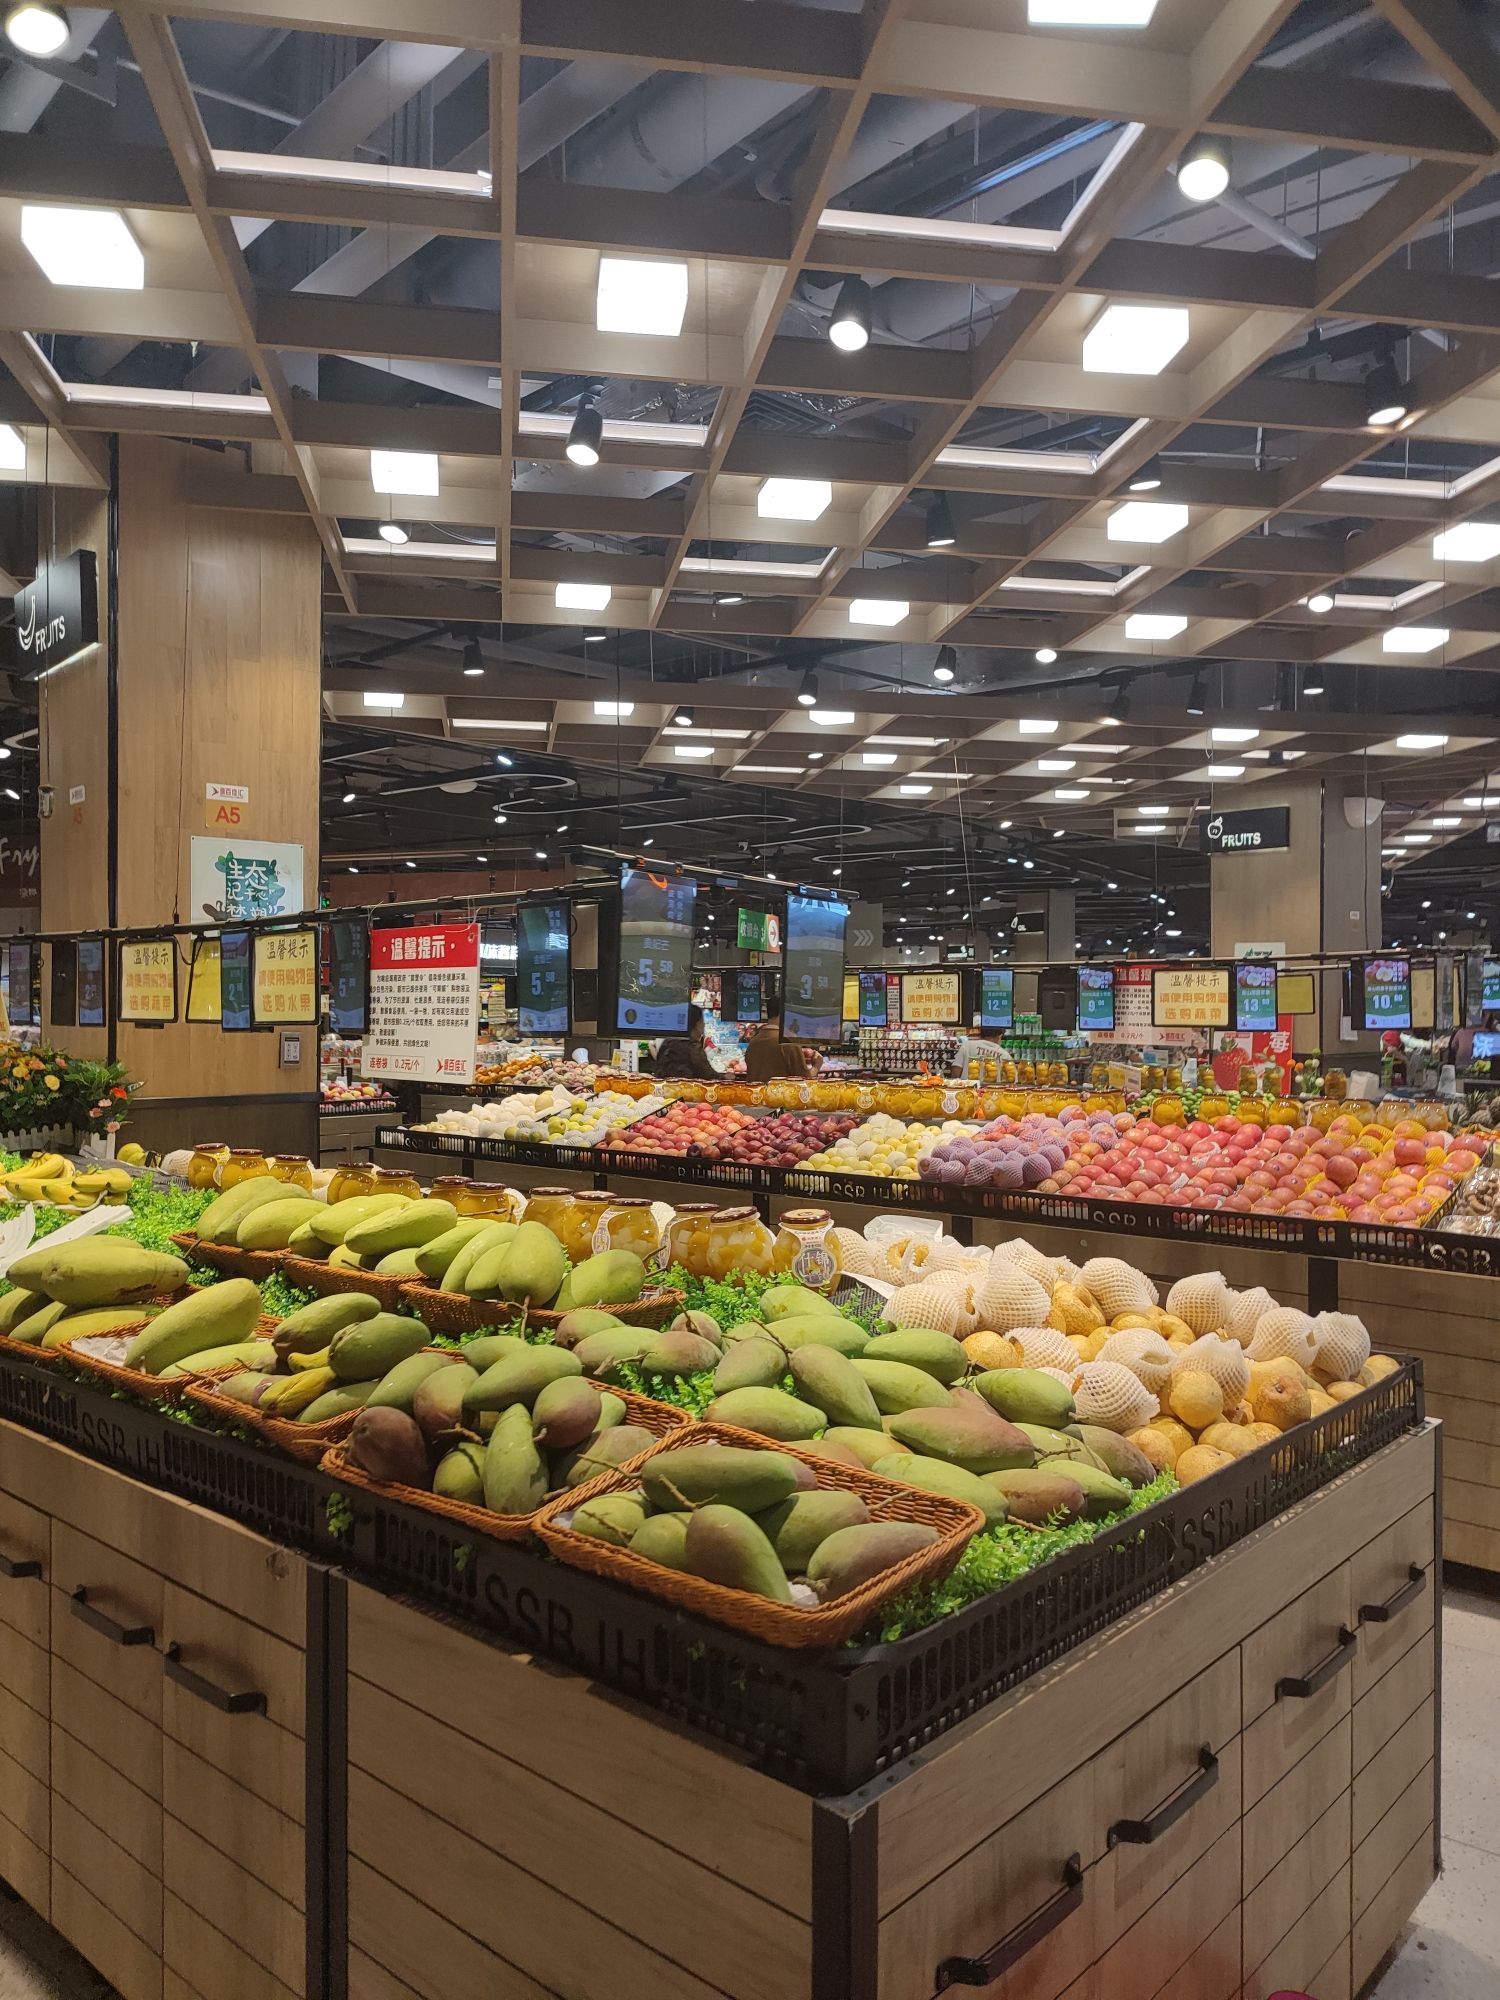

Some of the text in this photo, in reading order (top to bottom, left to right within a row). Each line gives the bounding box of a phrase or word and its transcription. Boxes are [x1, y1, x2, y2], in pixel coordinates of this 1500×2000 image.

[36, 616, 65, 655] FRUITS
[216, 806, 240, 824] A5
[1222, 832, 1261, 847] FRUITS
[226, 859, 269, 890] 生态
[267, 939, 308, 960] 温馨提示
[391, 935, 445, 960] 温馨提示
[133, 948, 169, 966] 温馨提示
[915, 978, 954, 990] 温馨提示
[1170, 974, 1221, 987] 温馨提示
[262, 993, 311, 1013] 选购水果
[1160, 992, 1228, 1004] 请使用购物篮
[369, 1057, 388, 1069] 连卷袋
[394, 1060, 420, 1072] 0.2元/个
